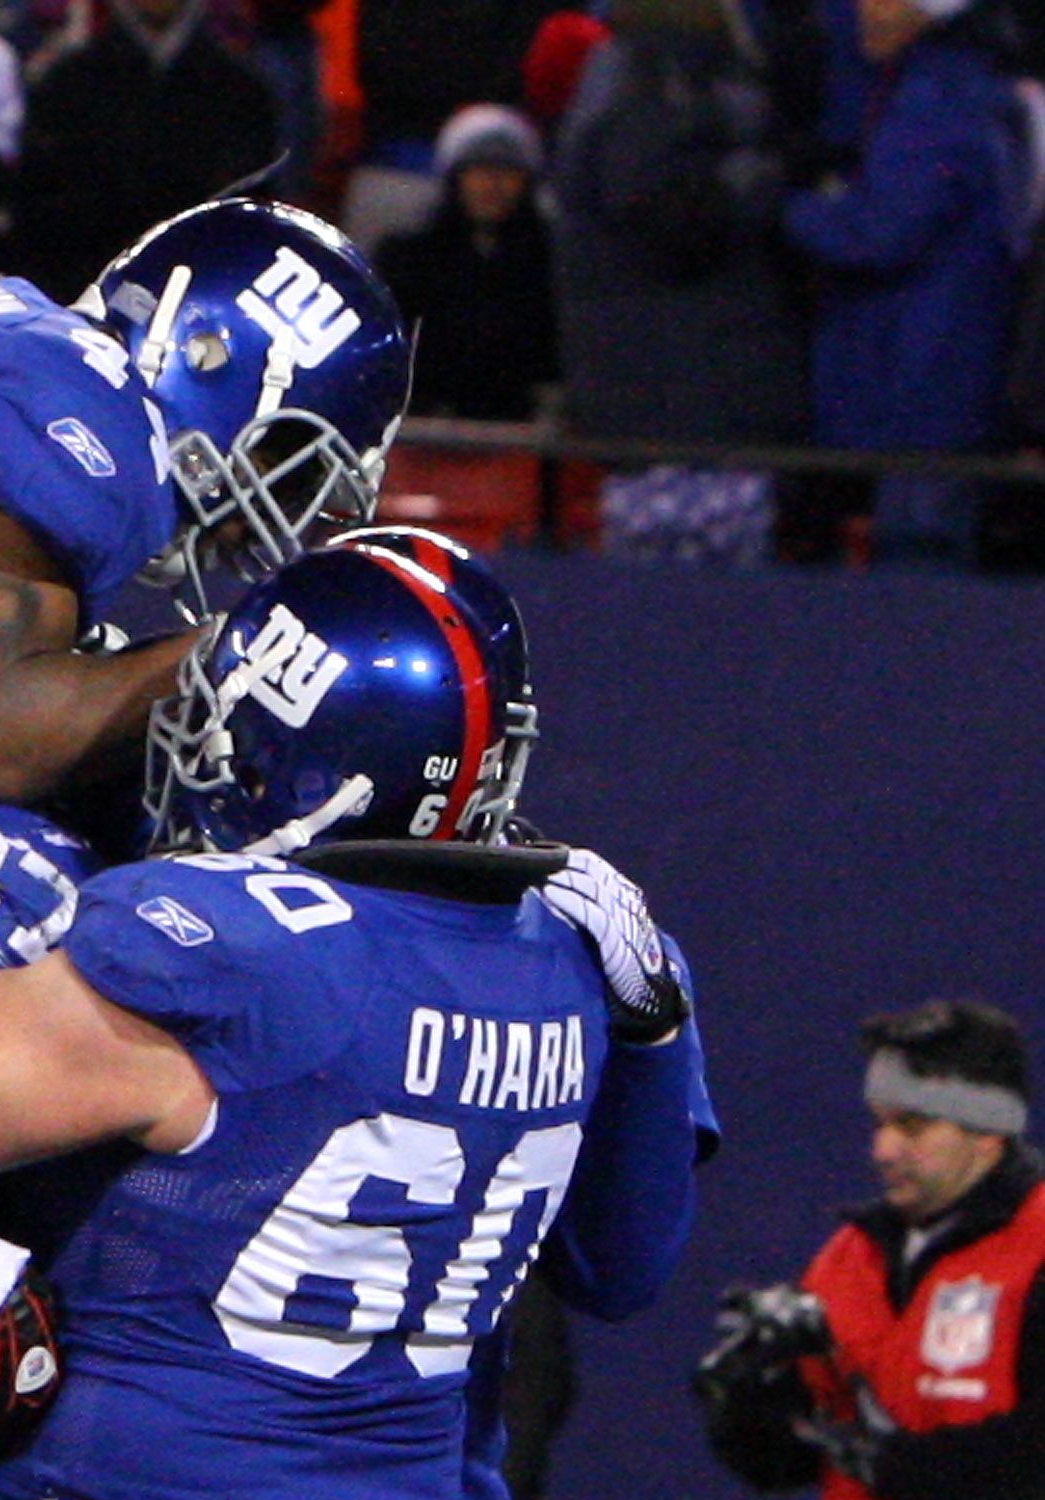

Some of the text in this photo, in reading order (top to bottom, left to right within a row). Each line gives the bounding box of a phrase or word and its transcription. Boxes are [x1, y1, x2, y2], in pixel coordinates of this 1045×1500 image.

[423, 756, 459, 781] GU
[404, 1006, 586, 1112] O'HARA
[211, 1112, 584, 1379] 60
